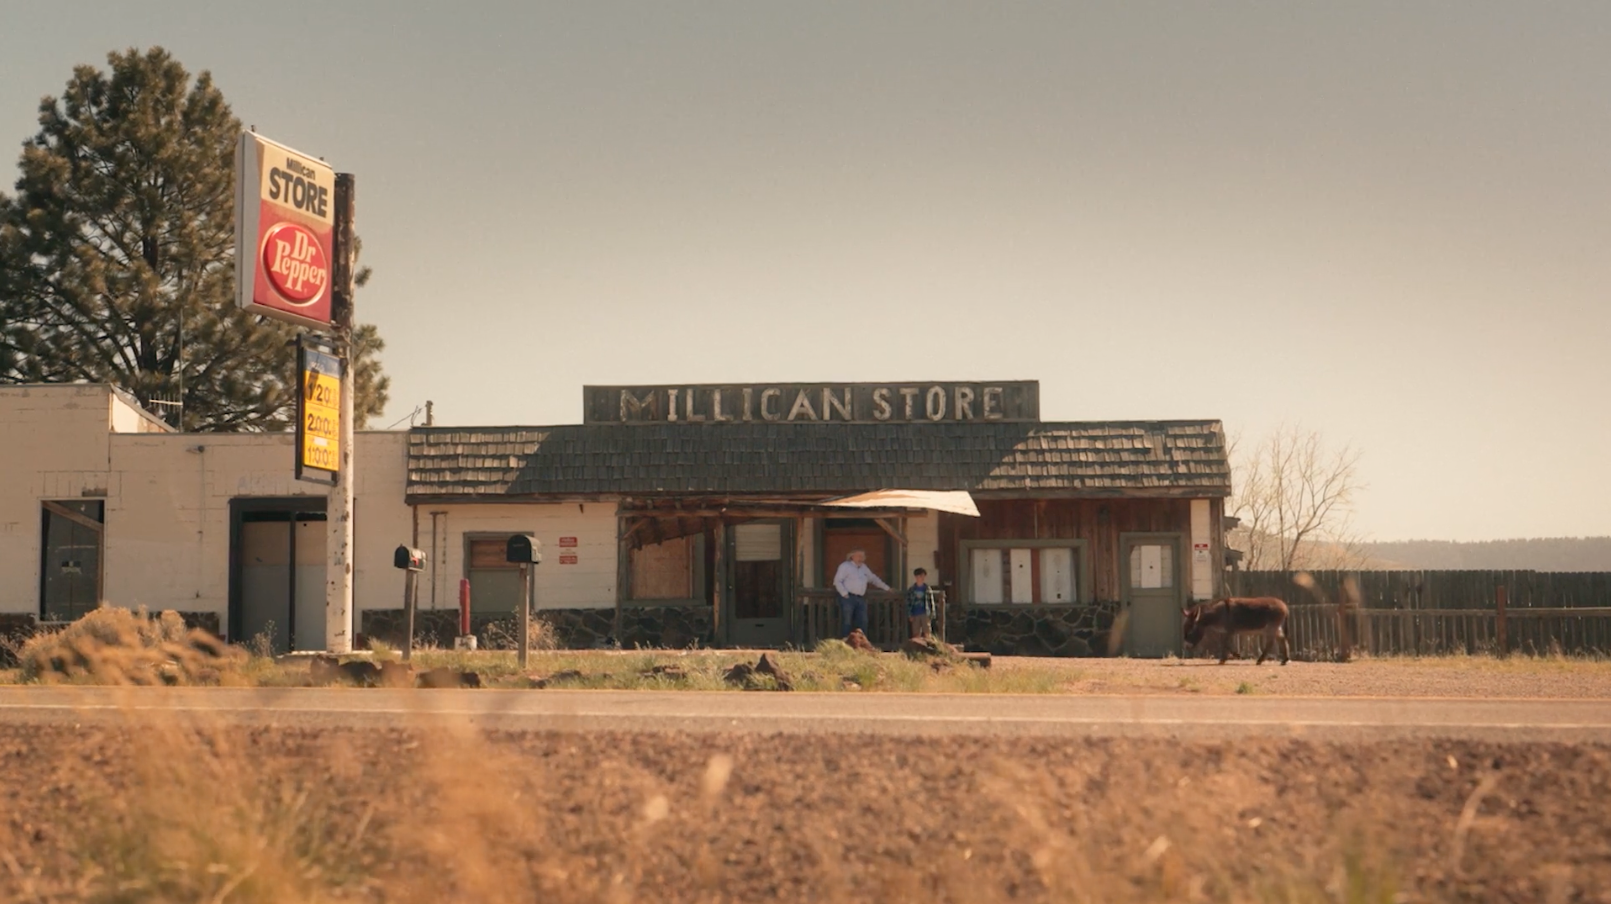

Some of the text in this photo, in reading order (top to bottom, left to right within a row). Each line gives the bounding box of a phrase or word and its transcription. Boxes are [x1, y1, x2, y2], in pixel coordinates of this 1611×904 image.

[269, 166, 328, 218] STORE
[271, 239, 326, 292] Pepper
[290, 230, 316, 263] Dr
[620, 385, 1003, 422] MILLICAN STORE
